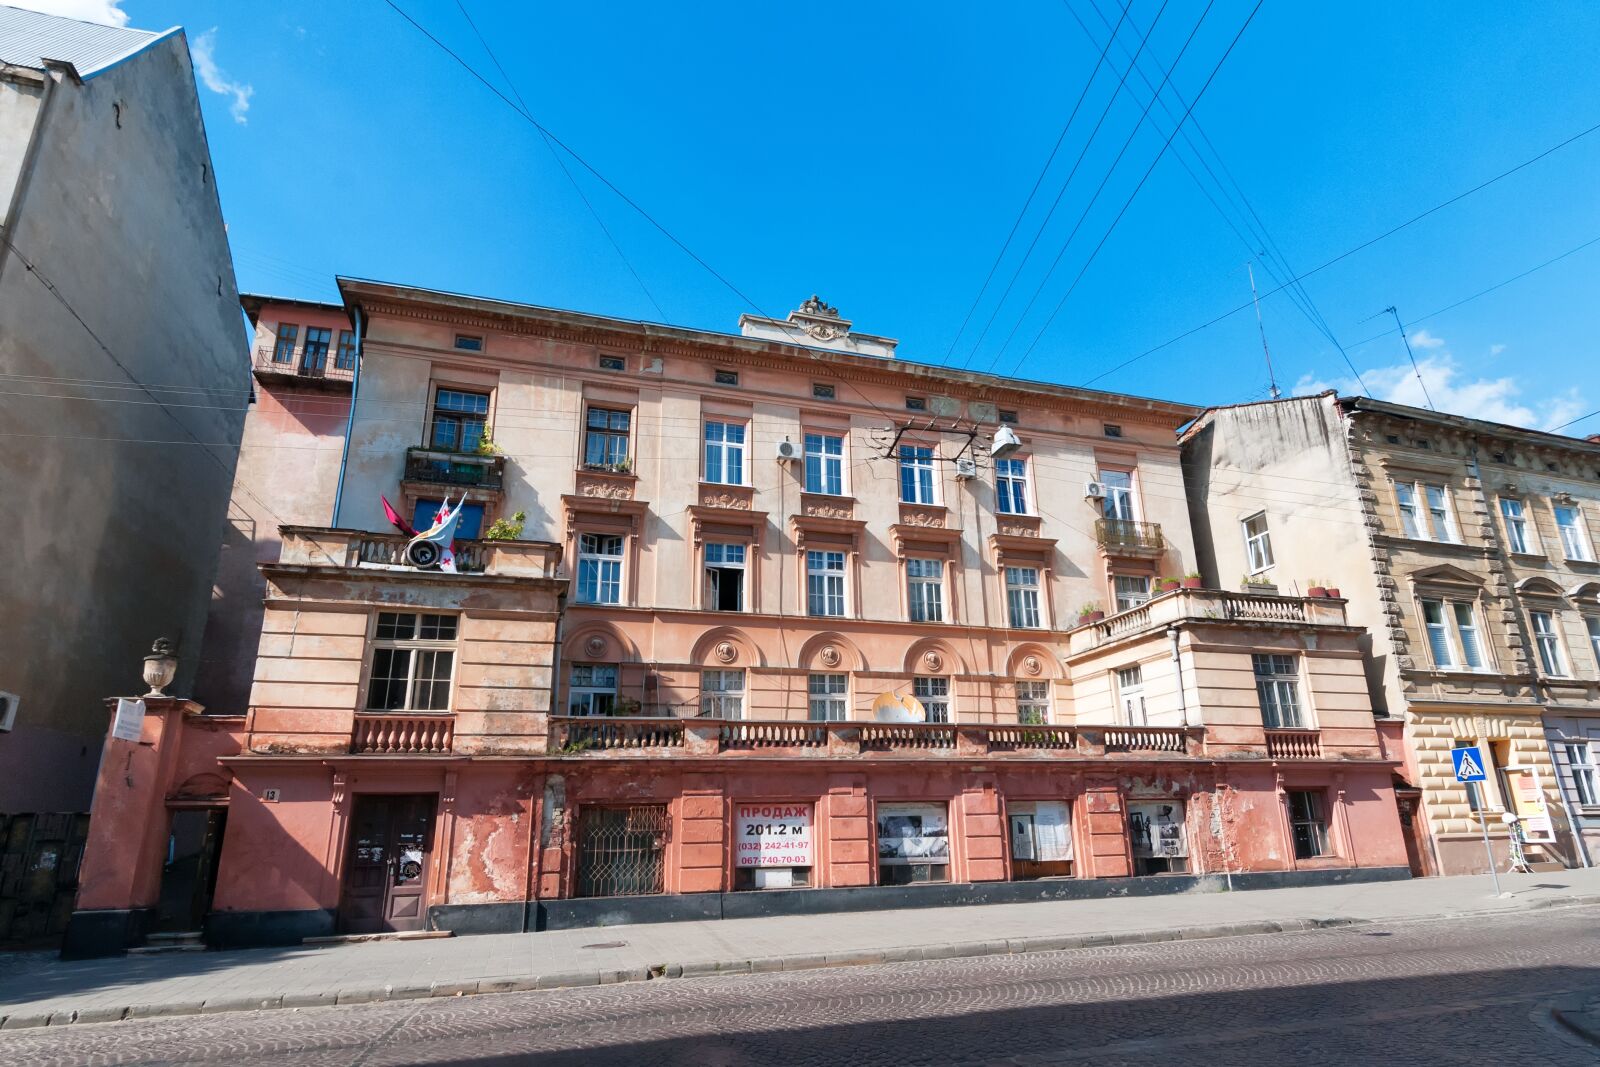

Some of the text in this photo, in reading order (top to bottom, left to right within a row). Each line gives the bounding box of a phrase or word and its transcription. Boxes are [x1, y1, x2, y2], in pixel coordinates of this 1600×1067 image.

[266, 790, 276, 800] 13
[740, 806, 808, 819] ПРОДАЖ
[746, 823, 787, 836] 201.2
[738, 841, 809, 852] (032) 242-41-97
[741, 855, 806, 865] 067-740-70-03
